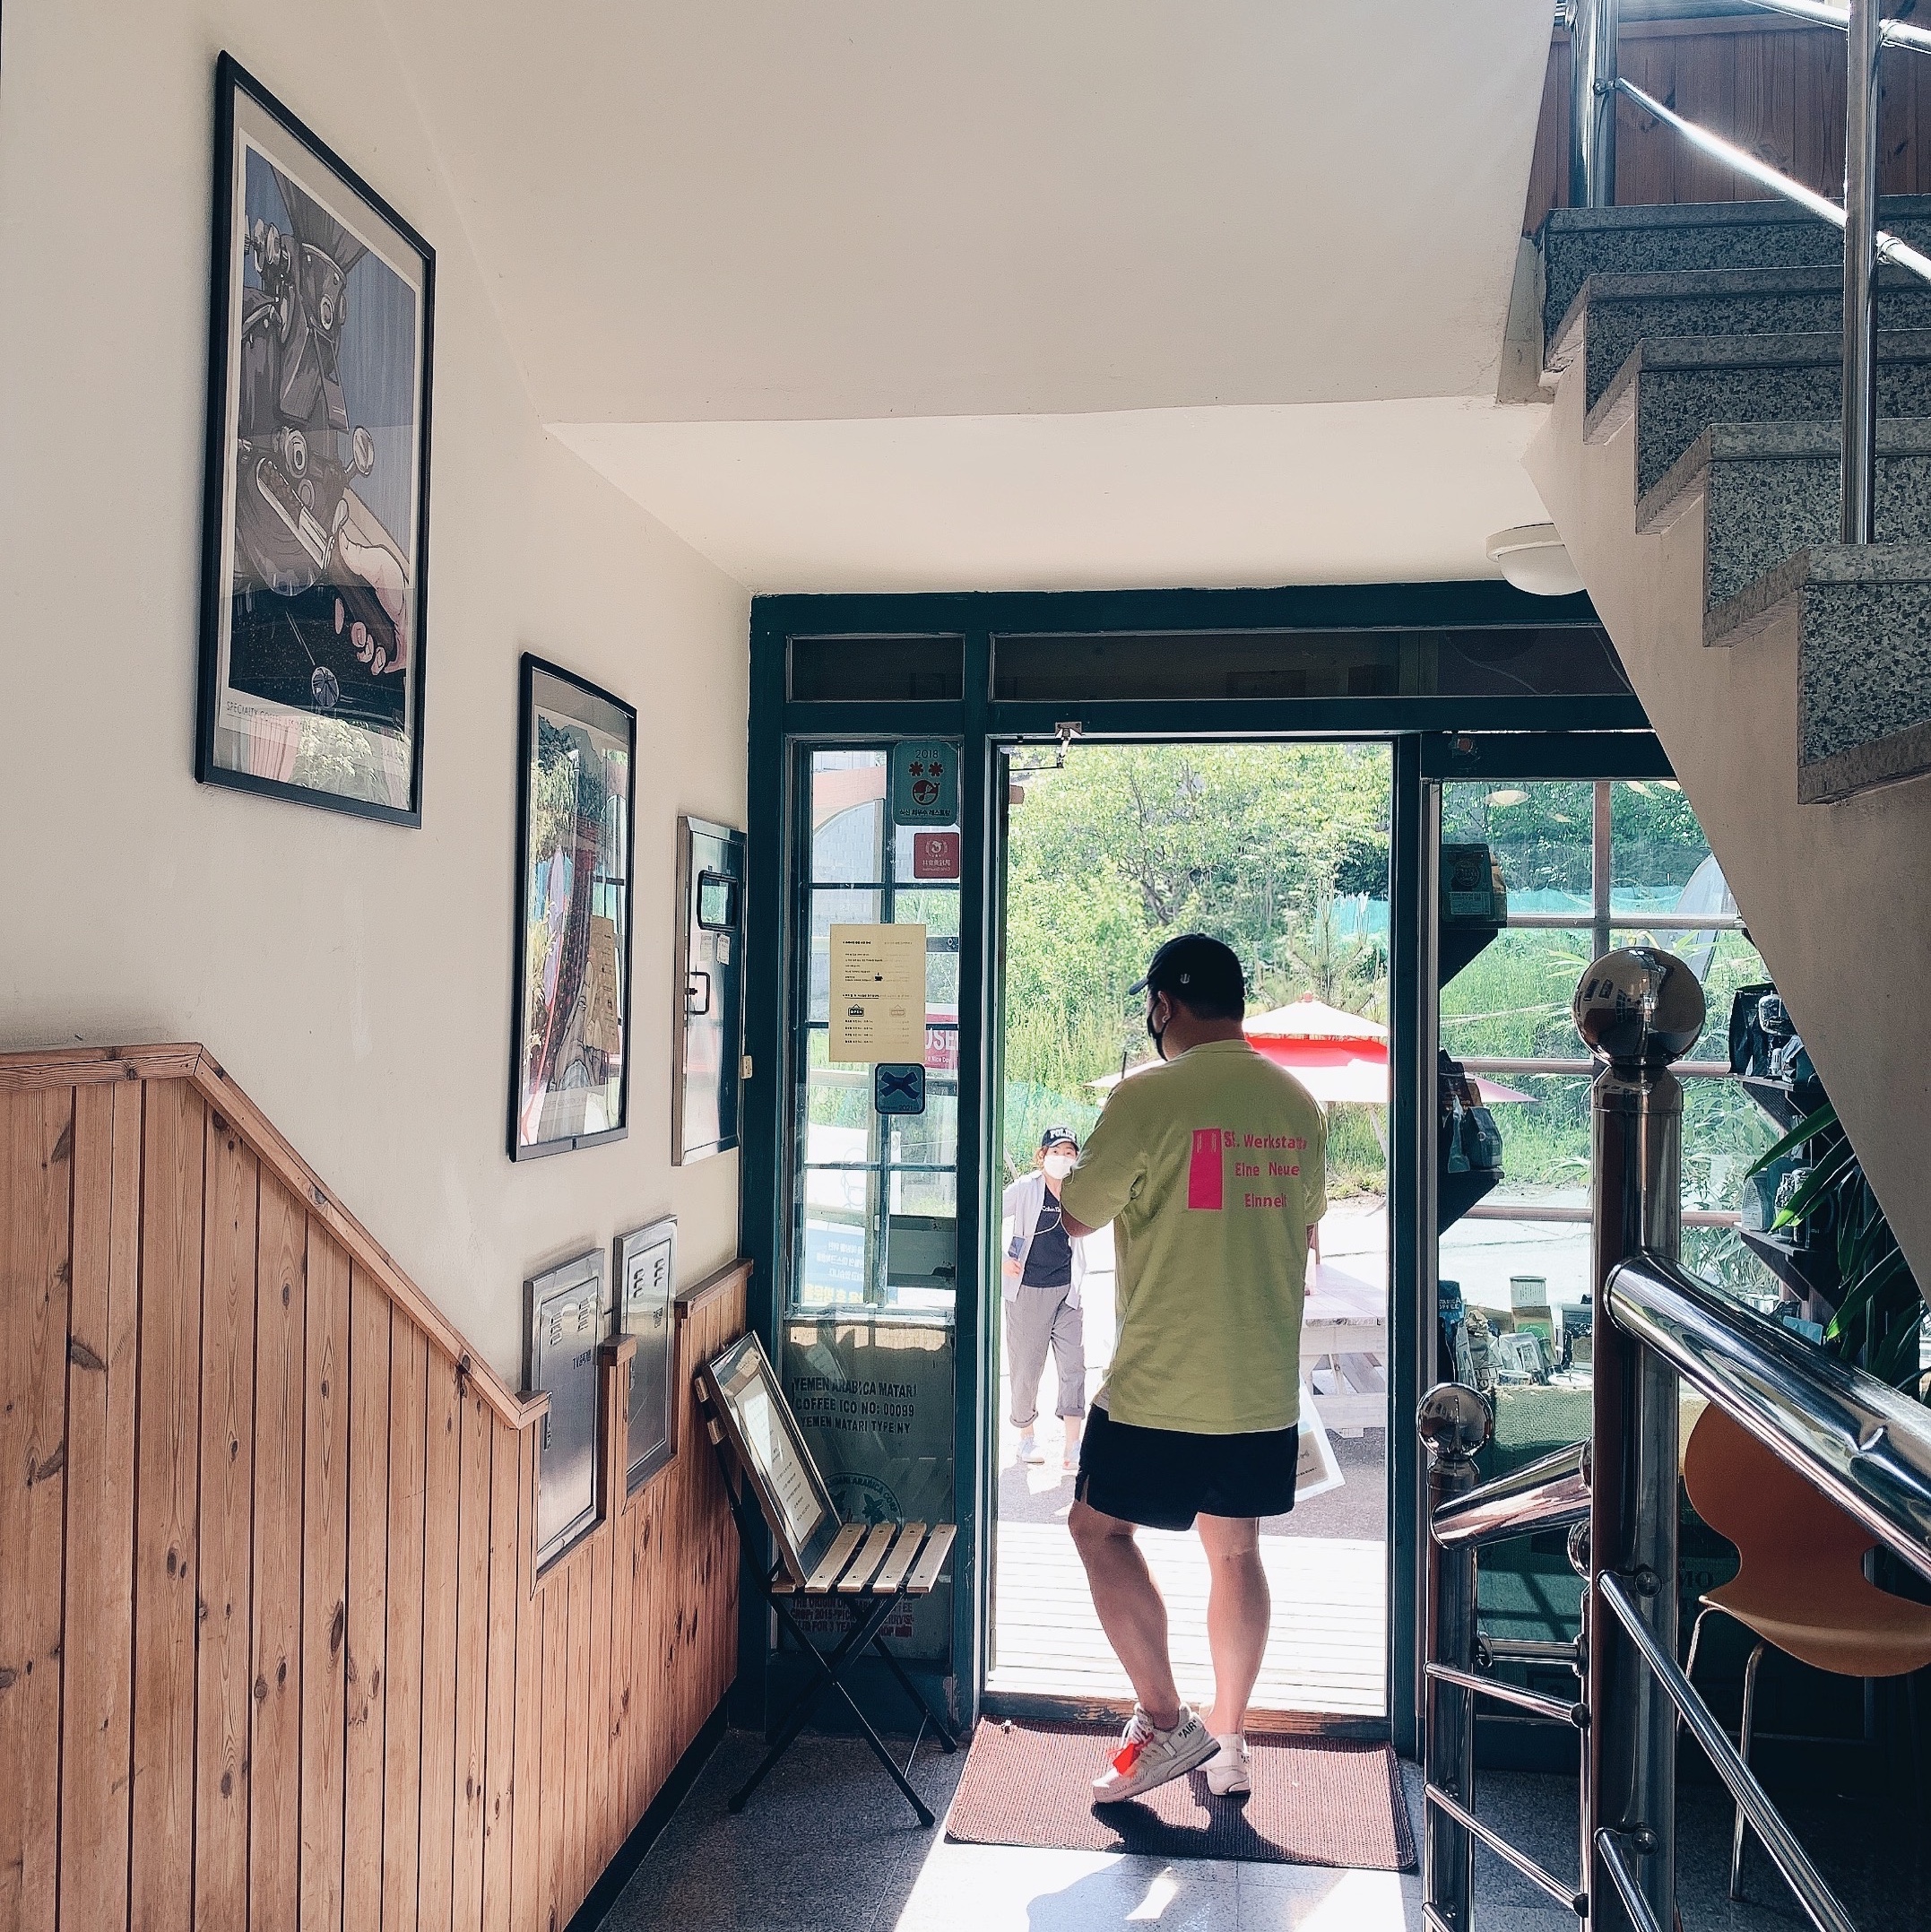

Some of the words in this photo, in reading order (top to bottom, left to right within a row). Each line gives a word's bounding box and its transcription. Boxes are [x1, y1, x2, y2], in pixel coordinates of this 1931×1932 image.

[226, 700, 258, 716] SPECIALTY
[914, 749, 939, 759] 2018
[1269, 1162, 1299, 1176] Neue
[793, 1376, 829, 1391] YEMEN
[832, 1380, 877, 1396] ARABICA
[879, 1382, 917, 1398] MATARI
[796, 1397, 836, 1411] COFFEE
[839, 1399, 857, 1414] ICO
[861, 1402, 880, 1415] NO:
[883, 1404, 914, 1417] 00099
[801, 1415, 832, 1428] YEMEN
[835, 1417, 868, 1432] MATARI
[871, 1420, 894, 1434] TYPE
